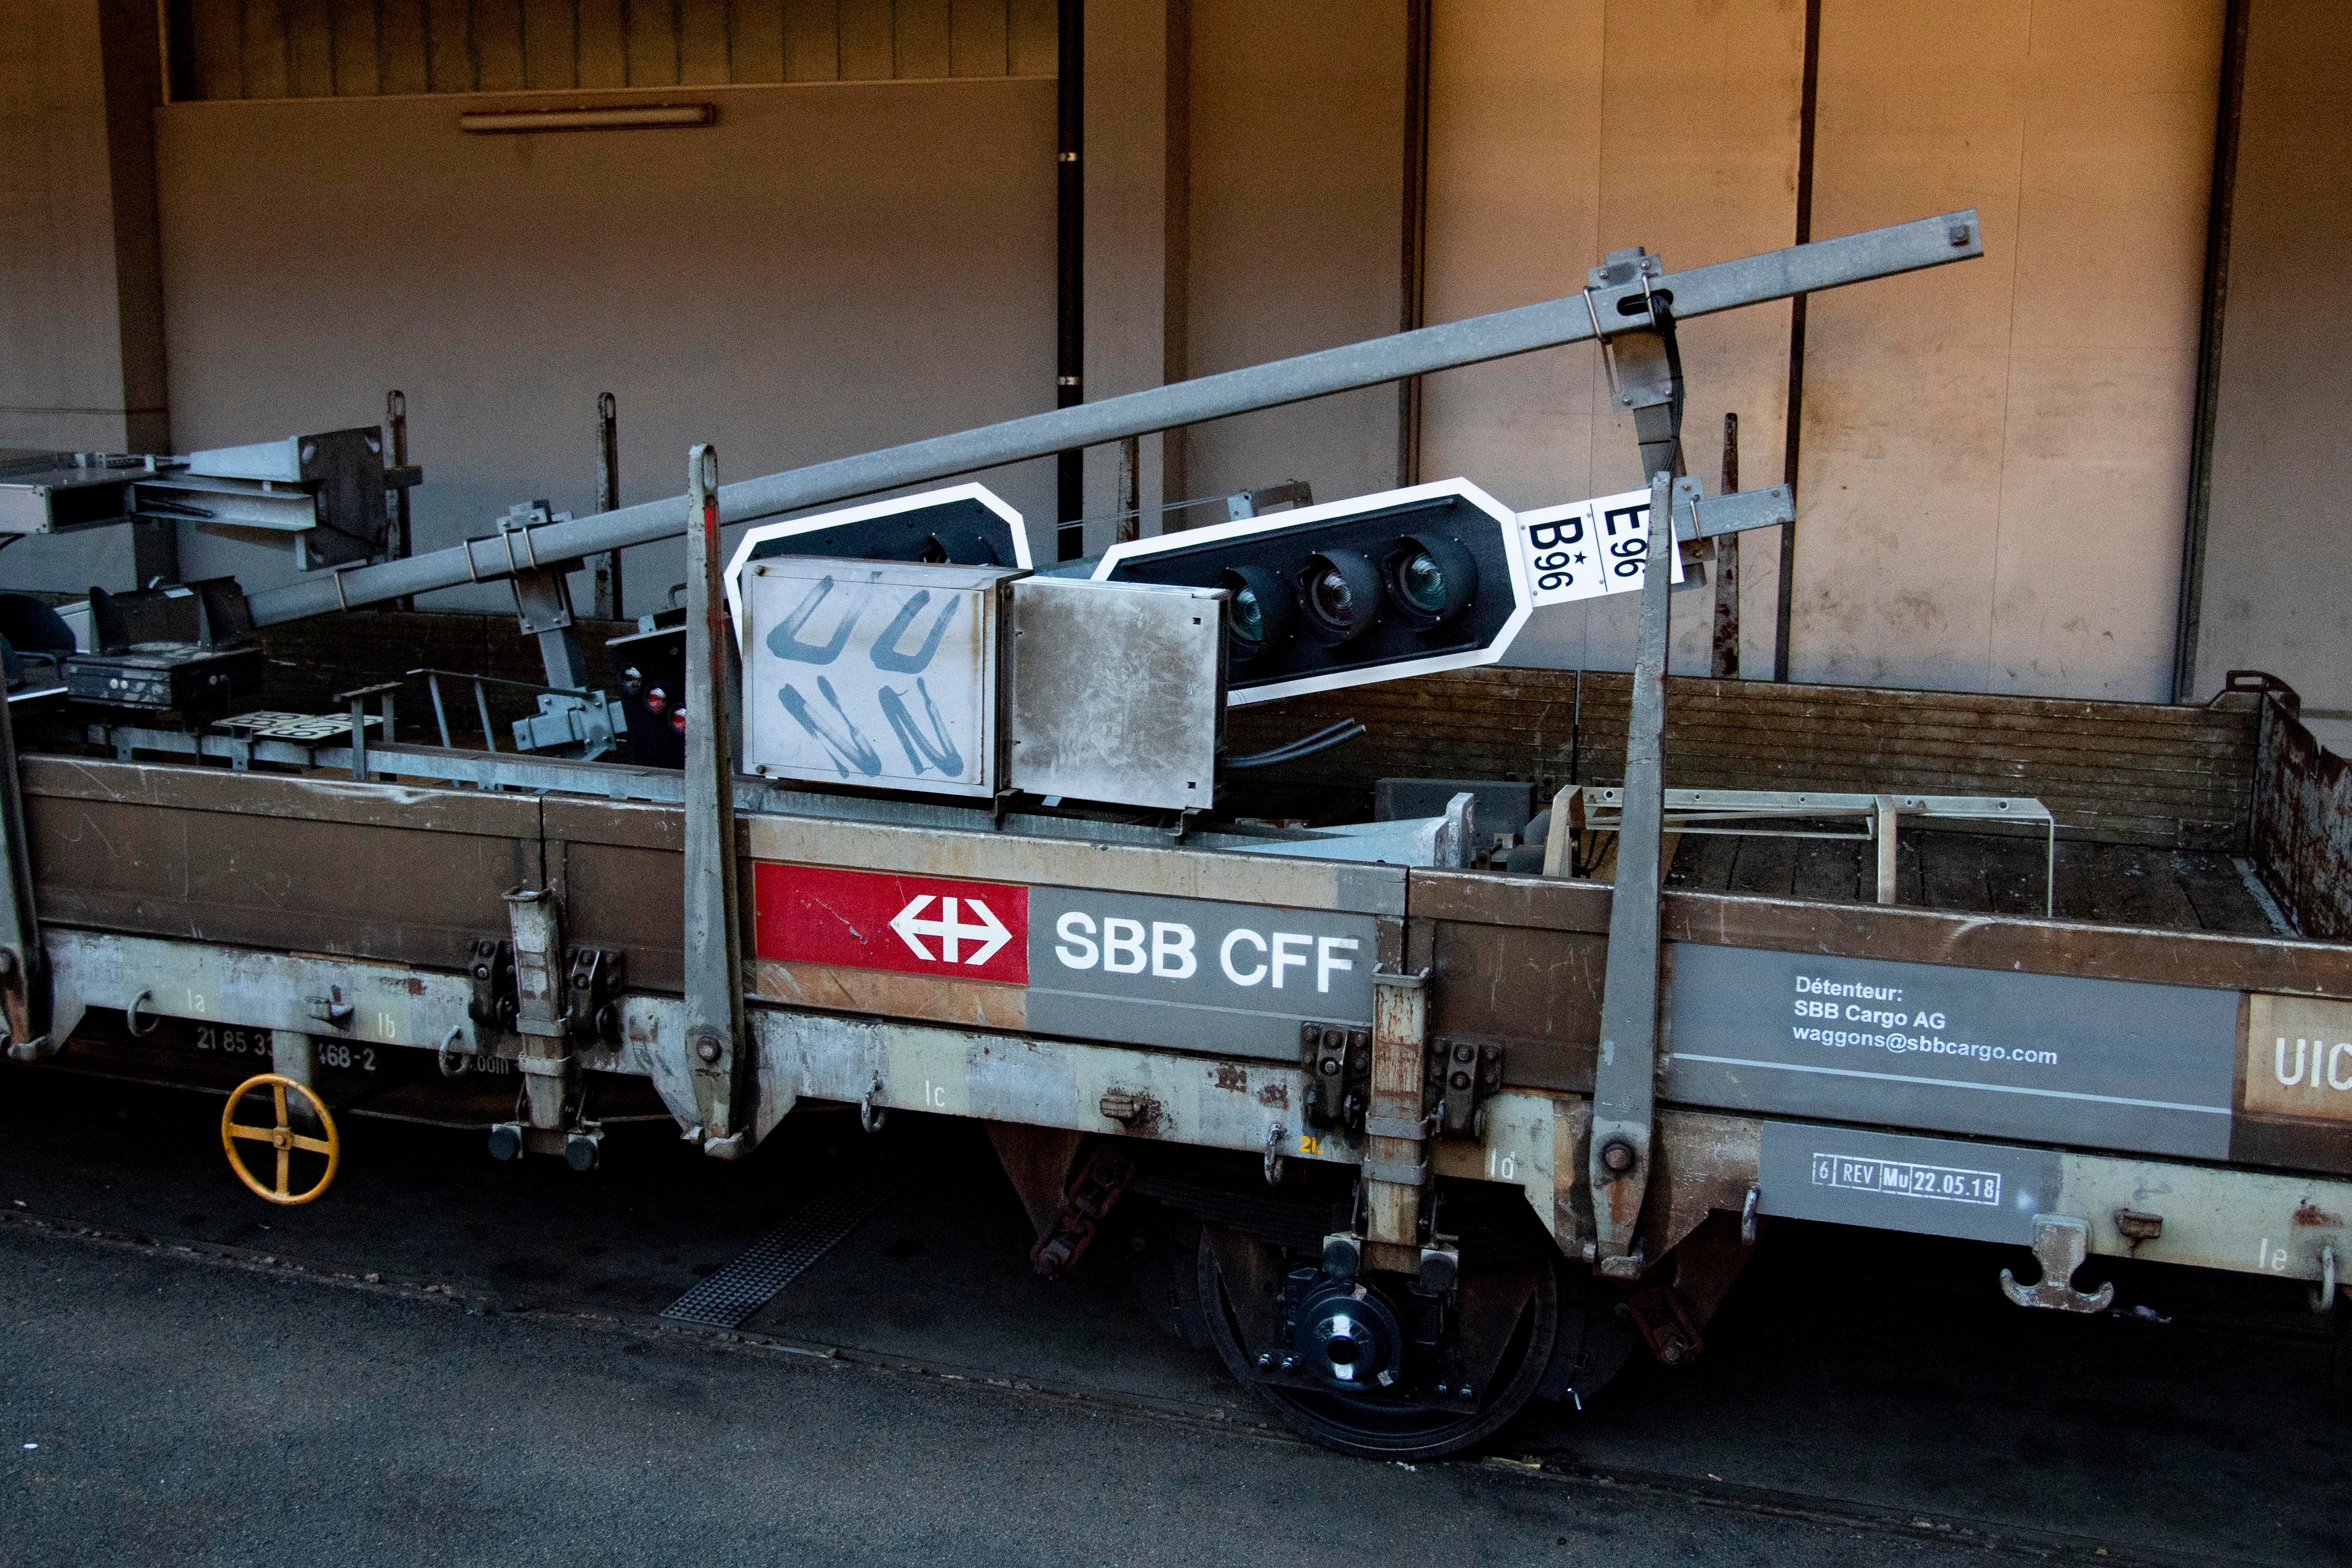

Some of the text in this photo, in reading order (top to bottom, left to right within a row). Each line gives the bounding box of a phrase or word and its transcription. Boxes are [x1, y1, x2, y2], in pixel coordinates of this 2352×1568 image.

[1055, 911, 1359, 993] SBB CFF
[1796, 976, 1902, 1001] Détenteur:
[1794, 1000, 1946, 1029] SBB Cargo AG
[197, 1026, 216, 1050] 21
[223, 1030, 247, 1053] 85
[1793, 1027, 2059, 1064] waggons@sbbcargo.com
[2274, 1037, 2352, 1090] UIC
[1819, 1161, 1995, 1199] 6 REV Mu 22.05.18
